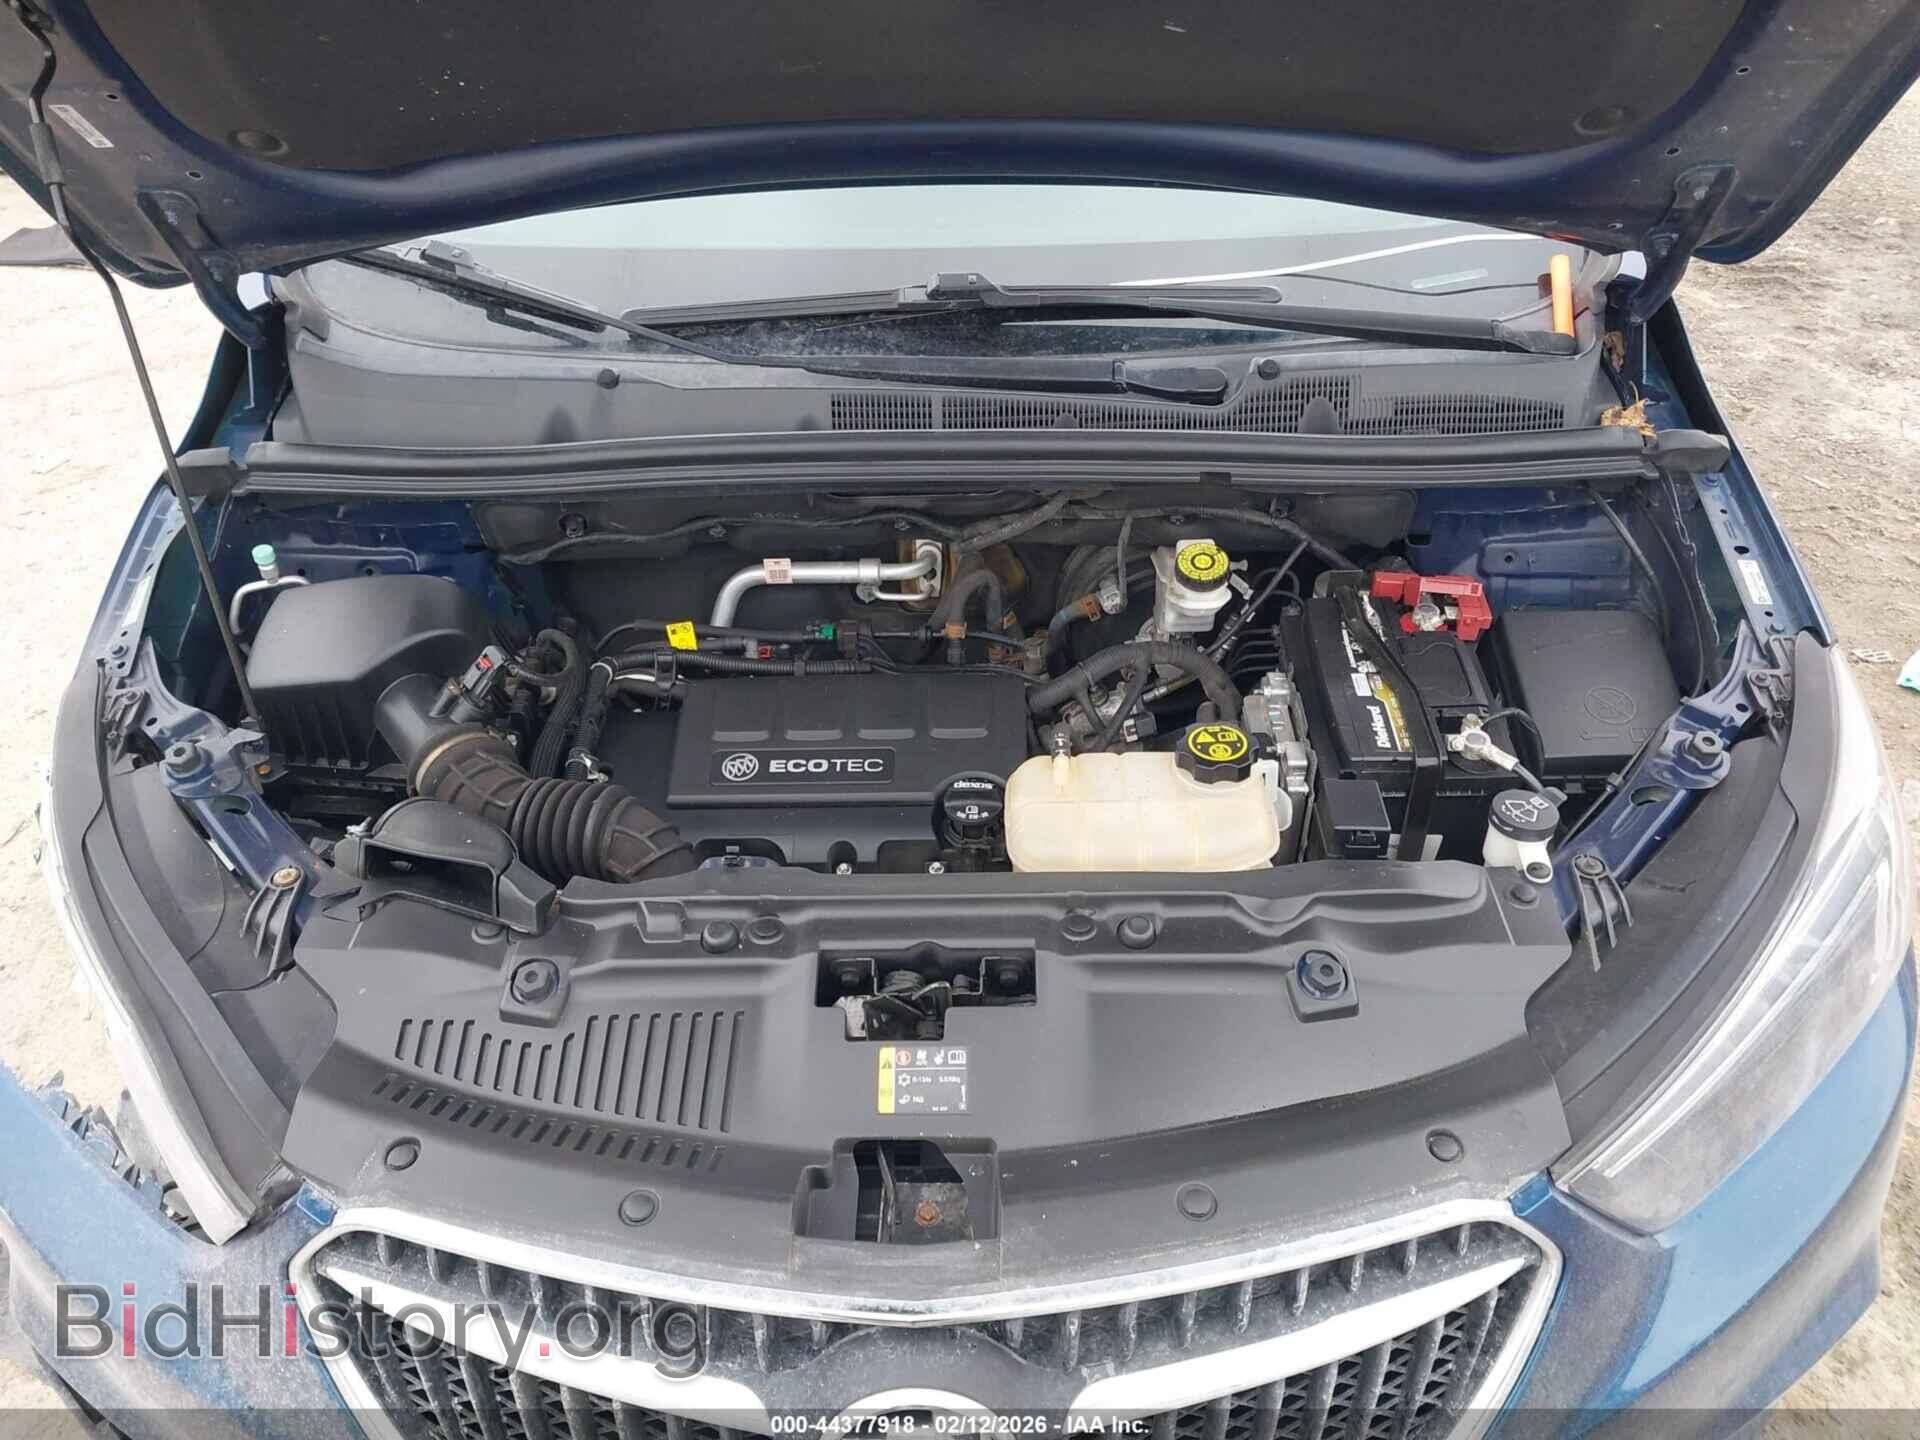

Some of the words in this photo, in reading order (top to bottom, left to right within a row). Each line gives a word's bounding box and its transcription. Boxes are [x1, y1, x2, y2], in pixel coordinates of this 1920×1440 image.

[1366, 705, 1392, 749] DieHard
[769, 758, 884, 773] ECOTEC
[954, 780, 993, 790] dexos
